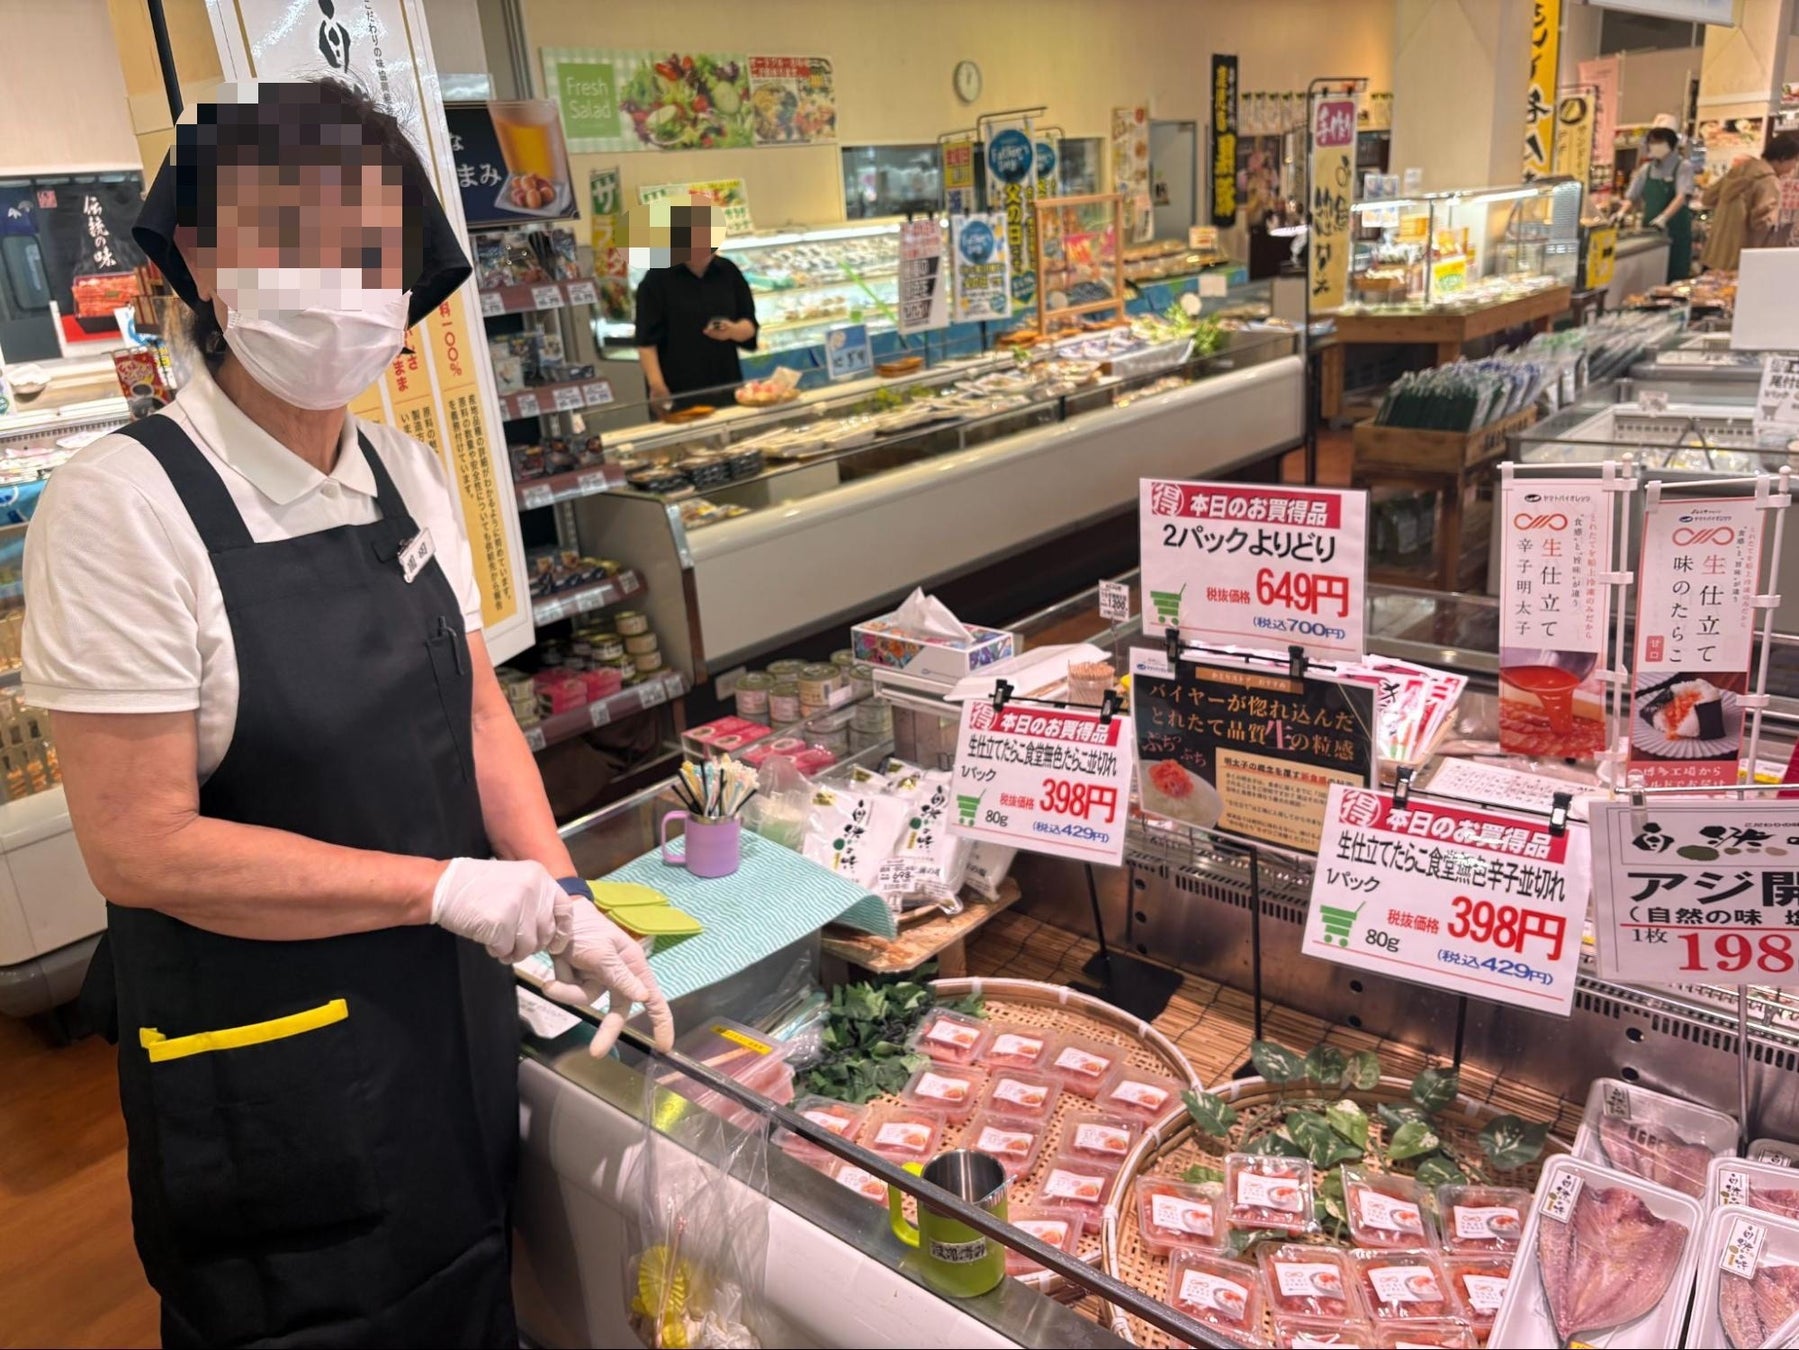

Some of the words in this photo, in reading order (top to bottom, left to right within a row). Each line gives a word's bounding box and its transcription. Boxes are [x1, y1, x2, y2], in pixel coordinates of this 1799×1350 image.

[566, 76, 609, 96] Fresh
[569, 100, 611, 119] Salad
[84, 195, 117, 269] 伝統の味
[1153, 483, 1182, 517] 得
[1190, 494, 1328, 526] 本日のお買得品
[1163, 524, 1335, 562] 2パックよりどり
[1207, 587, 1250, 604] 税抜価格
[1256, 568, 1349, 617] 649円
[1515, 538, 1534, 636] 辛子明太子
[1540, 538, 1562, 637] 生仕立て
[1669, 555, 1693, 663] 味のたらこ
[1696, 554, 1726, 662] 生仕立て
[1253, 617, 1345, 639] (税込700円)
[1001, 713, 1109, 744] 本日のお買得品
[1151, 683, 1354, 732] バイヤーが惚れ込んだ
[1151, 706, 1354, 761] とれたて品質生の粒感
[961, 765, 997, 782] 1パック
[985, 810, 1008, 827] 80g
[1000, 793, 1035, 811] 税抜価格
[1040, 778, 1118, 824] 398円
[1032, 821, 1109, 844] (税込429円)
[1340, 789, 1381, 828] 得
[1386, 808, 1553, 860] 本日のお買得品
[1326, 867, 1381, 893] 1パック
[1365, 928, 1400, 953] 80g
[1387, 908, 1440, 934] 税抜価格
[1447, 896, 1567, 962] 398円
[1632, 928, 1668, 944] 1枚
[1677, 932, 1795, 973] 198
[1437, 948, 1554, 986] (税込429円)
